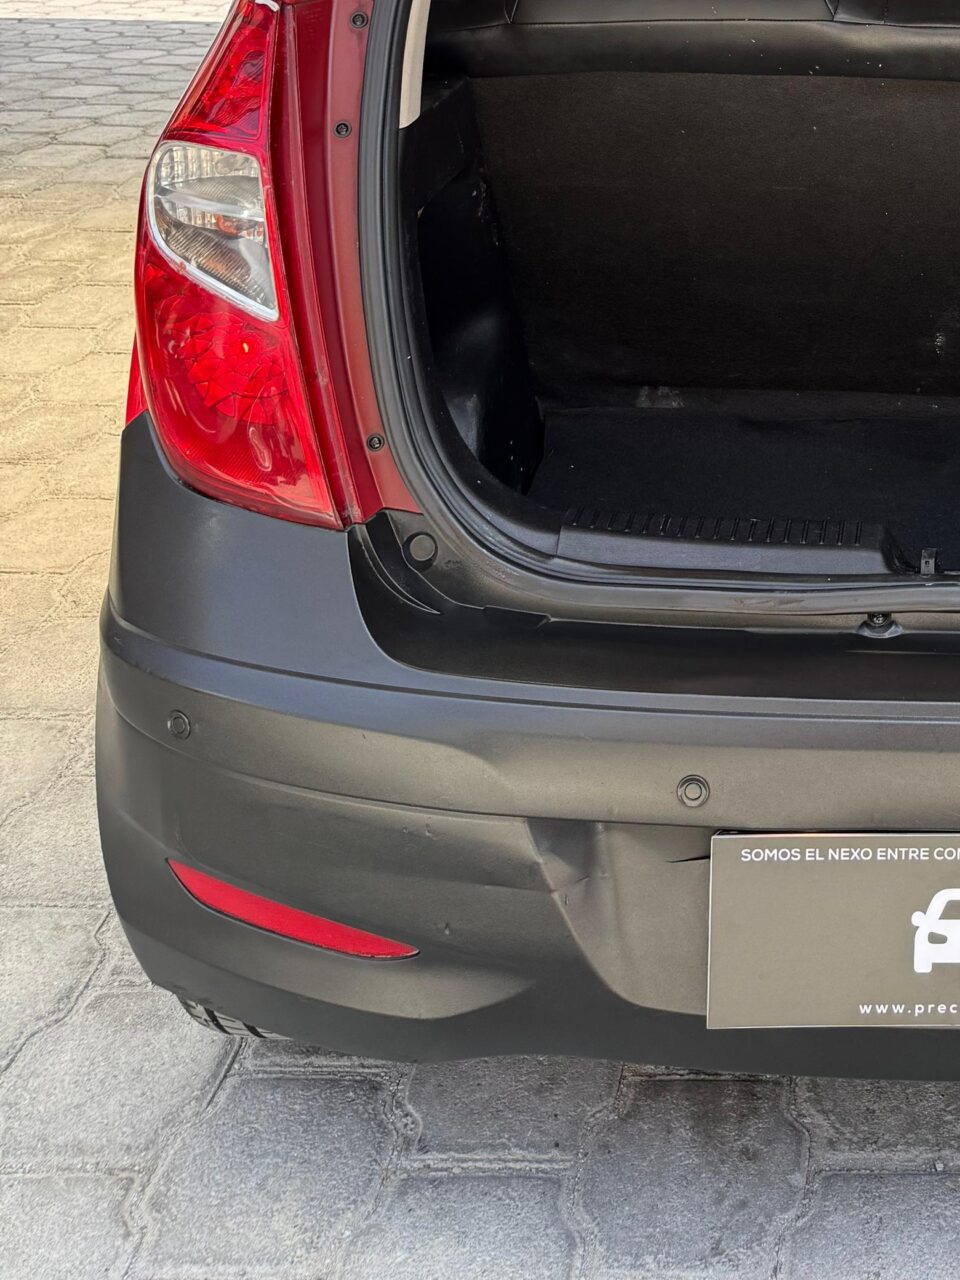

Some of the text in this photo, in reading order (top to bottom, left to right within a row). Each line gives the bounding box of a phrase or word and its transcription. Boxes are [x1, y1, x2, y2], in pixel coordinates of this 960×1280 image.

[741, 848, 801, 861] SOMOS
[805, 848, 824, 861] EL
[828, 848, 872, 861] NEXO
[877, 847, 929, 860] ENTRE
